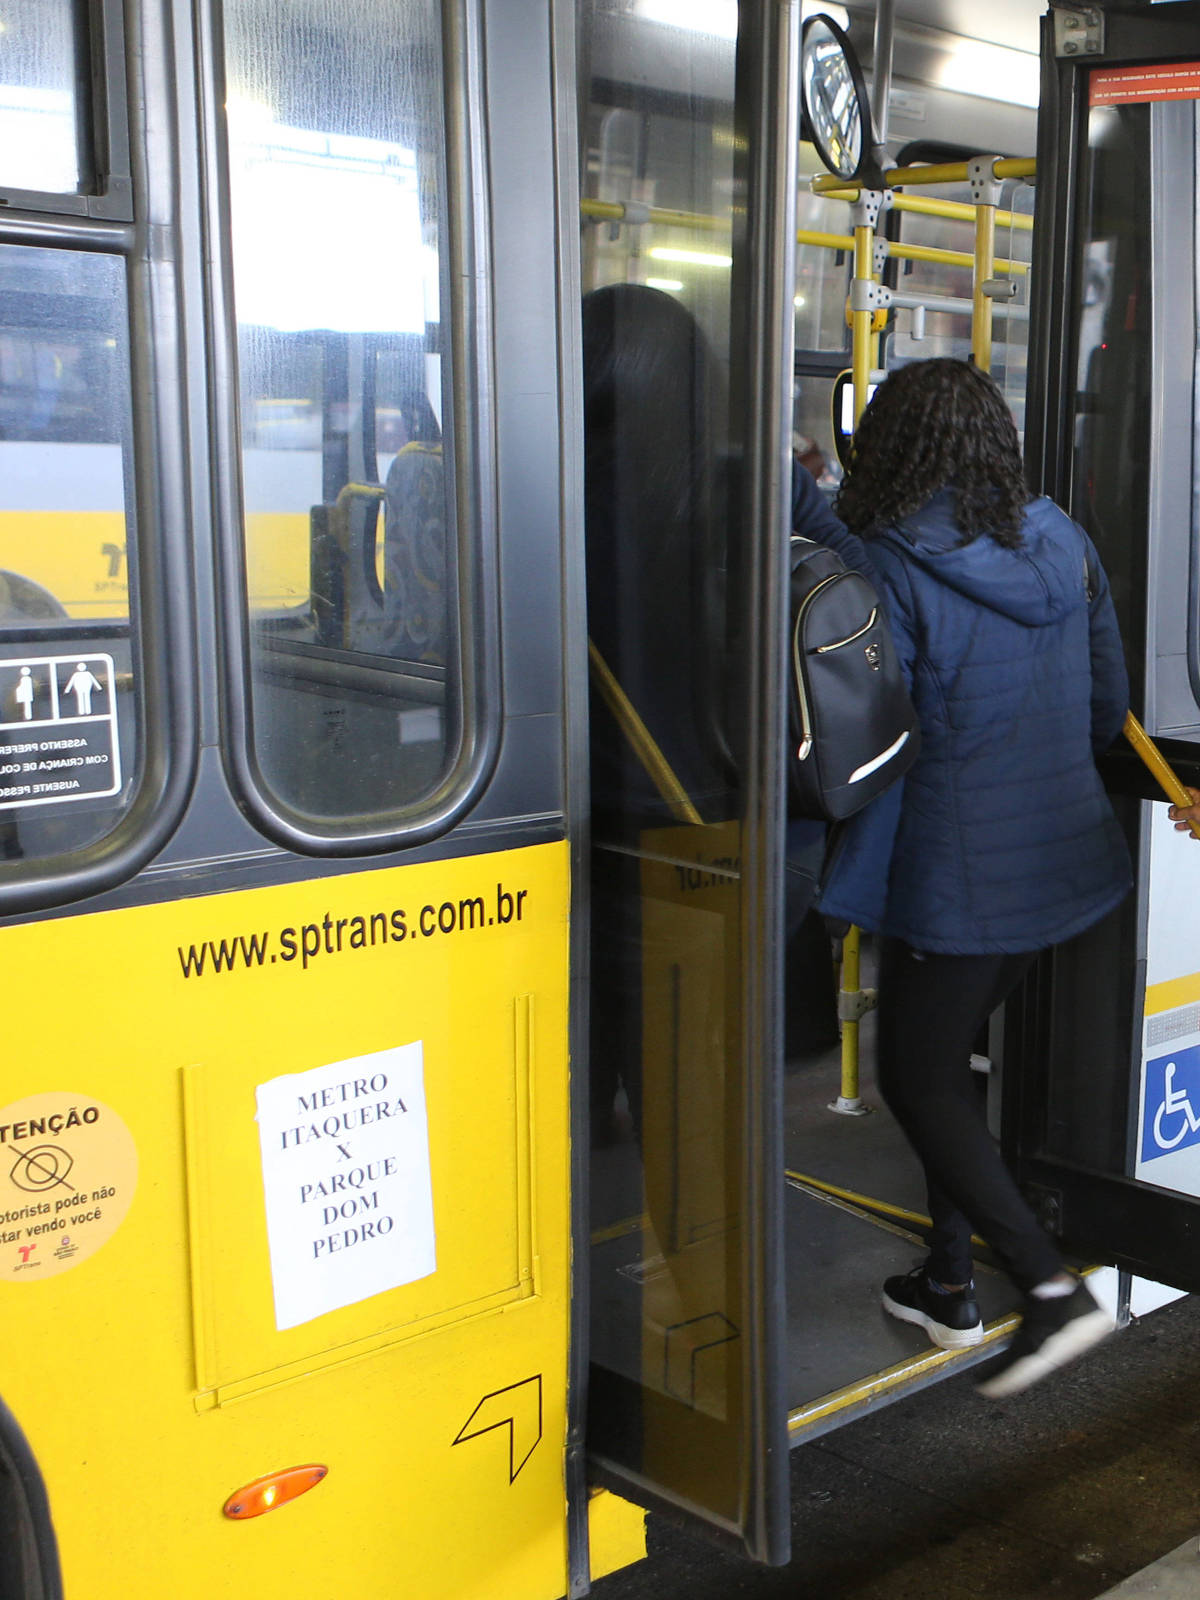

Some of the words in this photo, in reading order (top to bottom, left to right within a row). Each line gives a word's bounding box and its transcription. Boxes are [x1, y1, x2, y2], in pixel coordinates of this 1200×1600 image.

[178, 883, 528, 979] www.sptrans.com.br
[298, 1073, 388, 1115] METRO
[0, 1106, 100, 1143] TENÇÃO
[280, 1098, 408, 1150] ITAQUERA
[336, 1142, 352, 1163] X
[55, 1192, 88, 1213] pode
[92, 1186, 116, 1201] não
[300, 1156, 398, 1204] PARQUE
[26, 1218, 66, 1237] vendo
[71, 1207, 102, 1225] você
[323, 1191, 379, 1226] DOM
[313, 1216, 394, 1259] PEDRO
